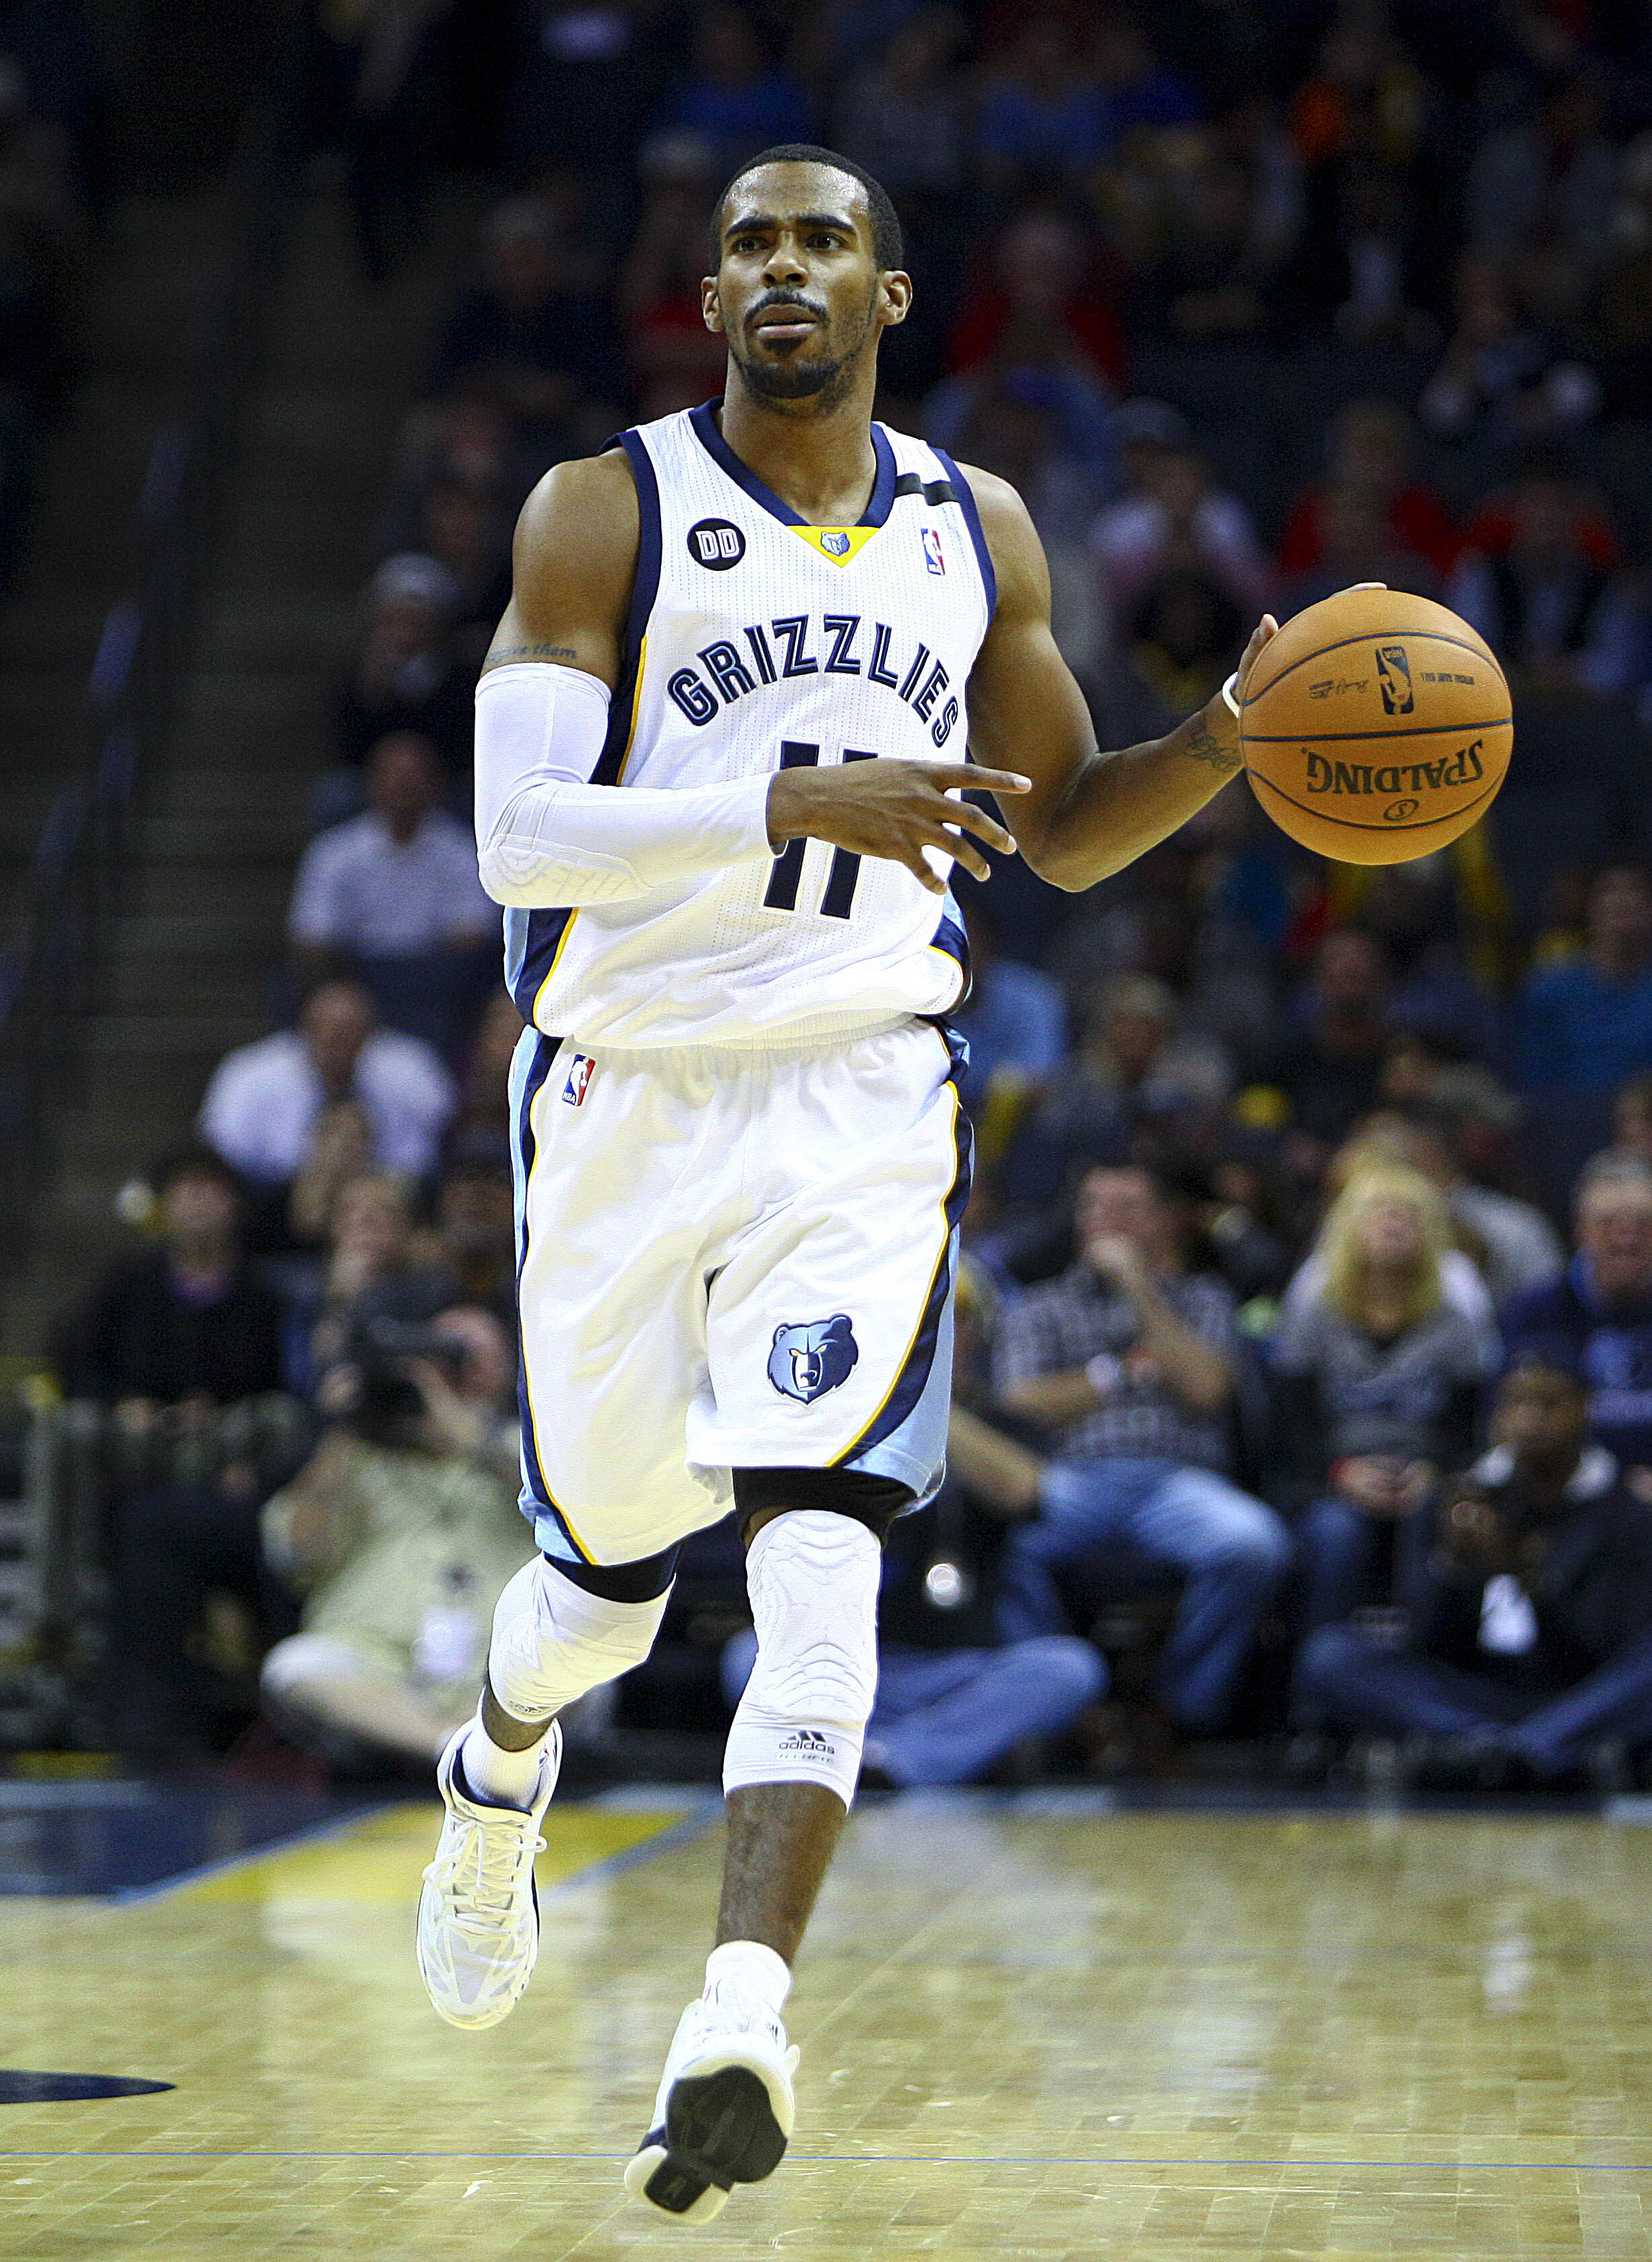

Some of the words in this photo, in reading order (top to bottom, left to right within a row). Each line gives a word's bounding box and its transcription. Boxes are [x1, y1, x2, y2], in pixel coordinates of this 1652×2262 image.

[695, 528, 741, 561] DD
[667, 613, 959, 748] GRIZZLIES
[1306, 740, 1483, 794] SPALDING
[779, 1740, 835, 1754] adidas
